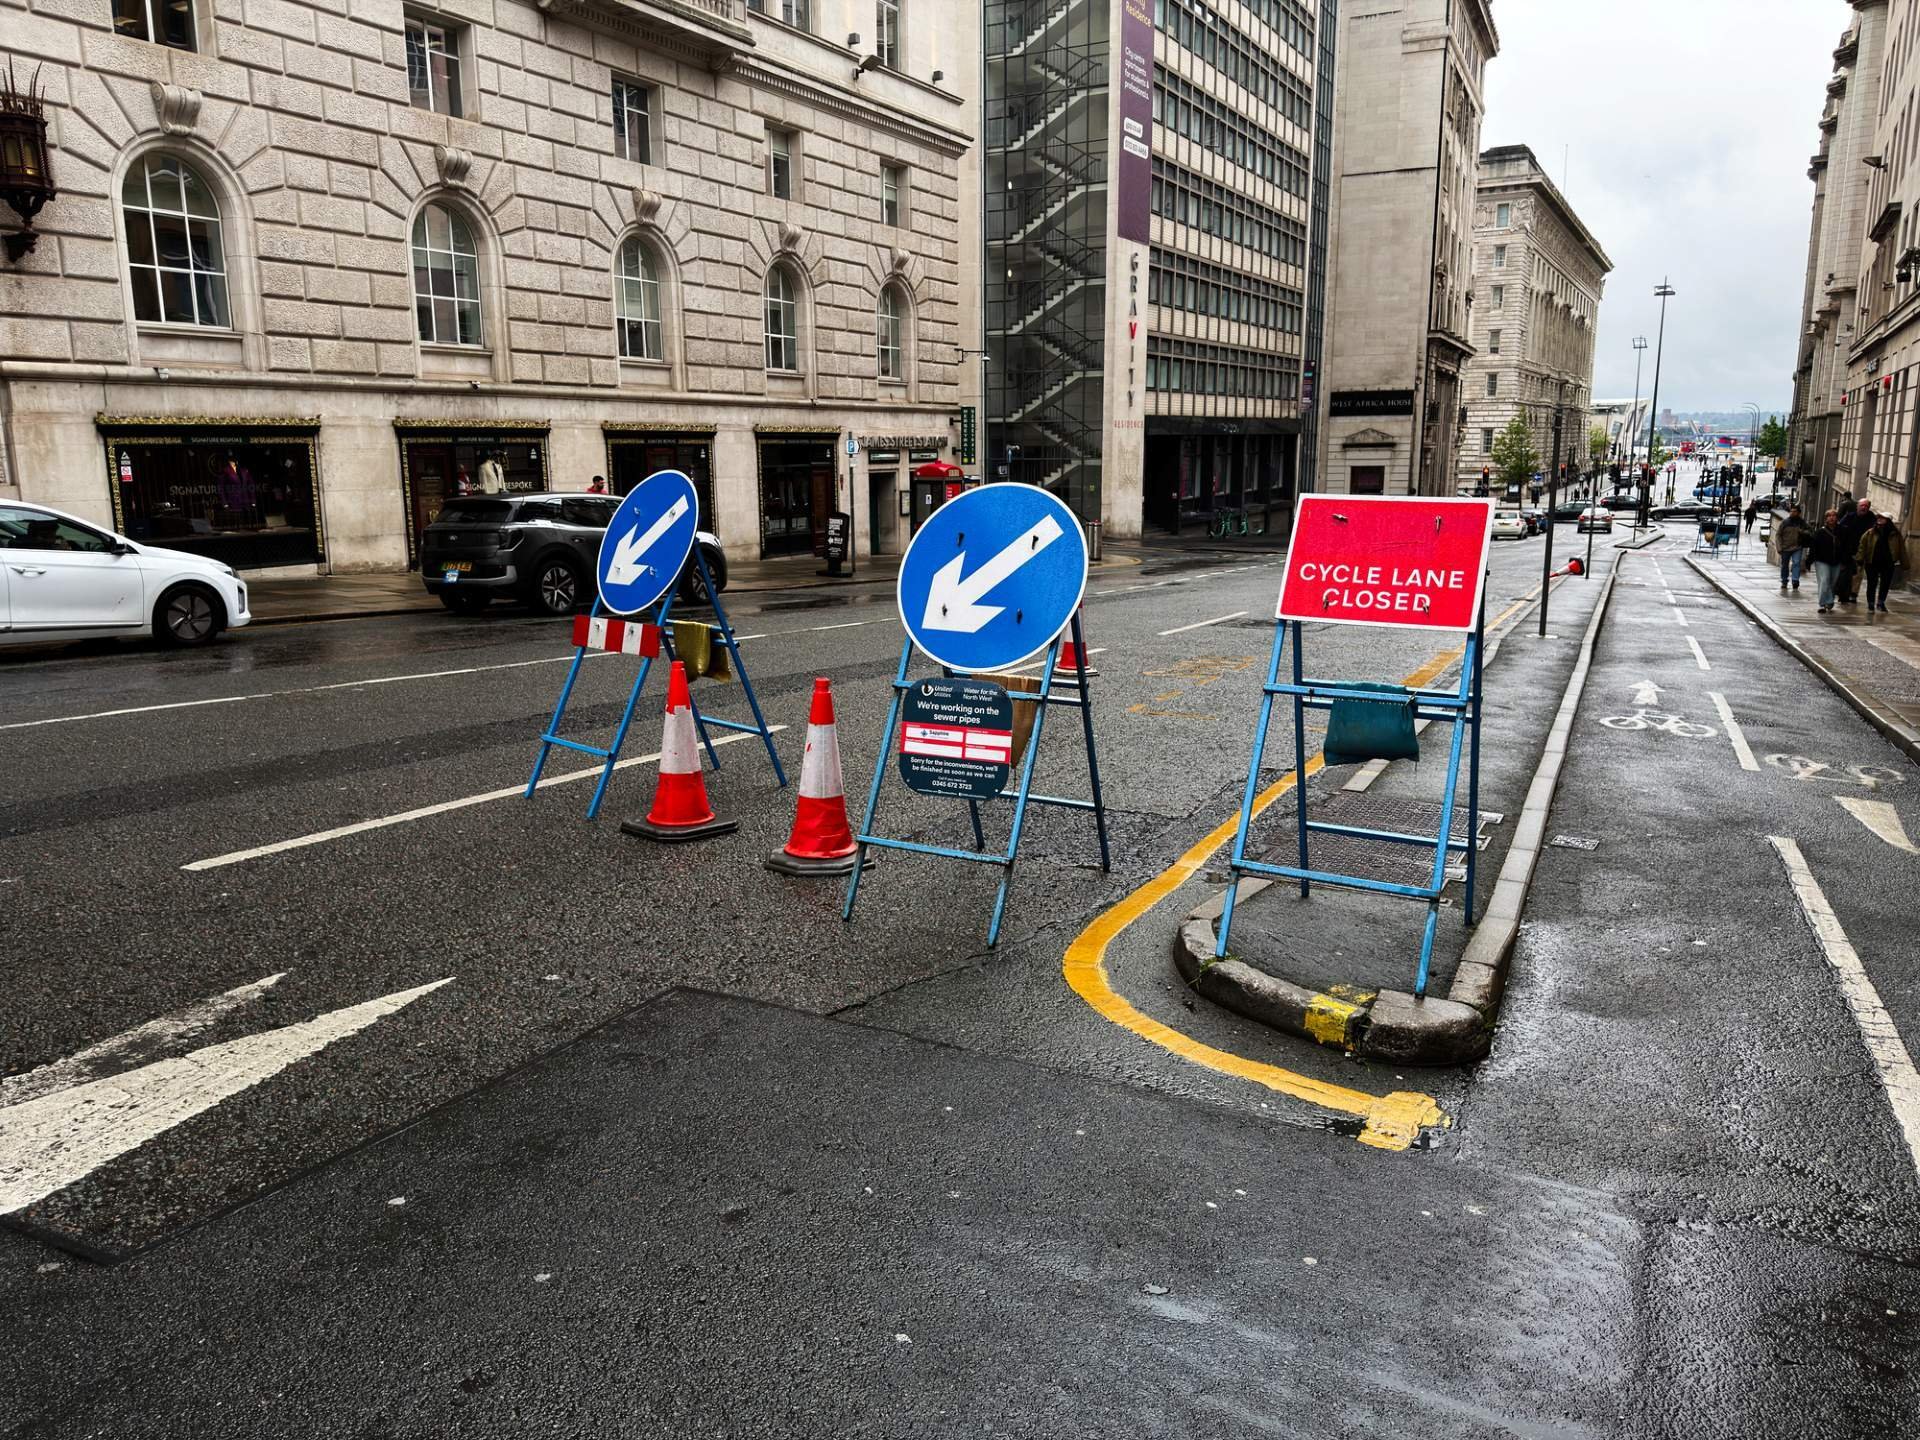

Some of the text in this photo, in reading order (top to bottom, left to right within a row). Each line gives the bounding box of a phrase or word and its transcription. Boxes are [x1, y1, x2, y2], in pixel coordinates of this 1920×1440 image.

[1126, 1, 1151, 27] Residence
[1127, 252, 1138, 407] GRAVITY
[1331, 400, 1351, 408] WEST
[1112, 419, 1144, 429] RESIDENCE
[1299, 562, 1465, 589] CYCLE LANE
[1322, 588, 1432, 613] CLOSED
[934, 685, 953, 693] United
[917, 700, 940, 710] We're
[940, 703, 973, 715] working
[986, 706, 1000, 715] the
[933, 713, 981, 724] sewer pipes
[910, 756, 925, 765] Sorry
[943, 761, 985, 771] inconvenience,
[920, 765, 943, 774] finished
[931, 780, 947, 788] 0345
